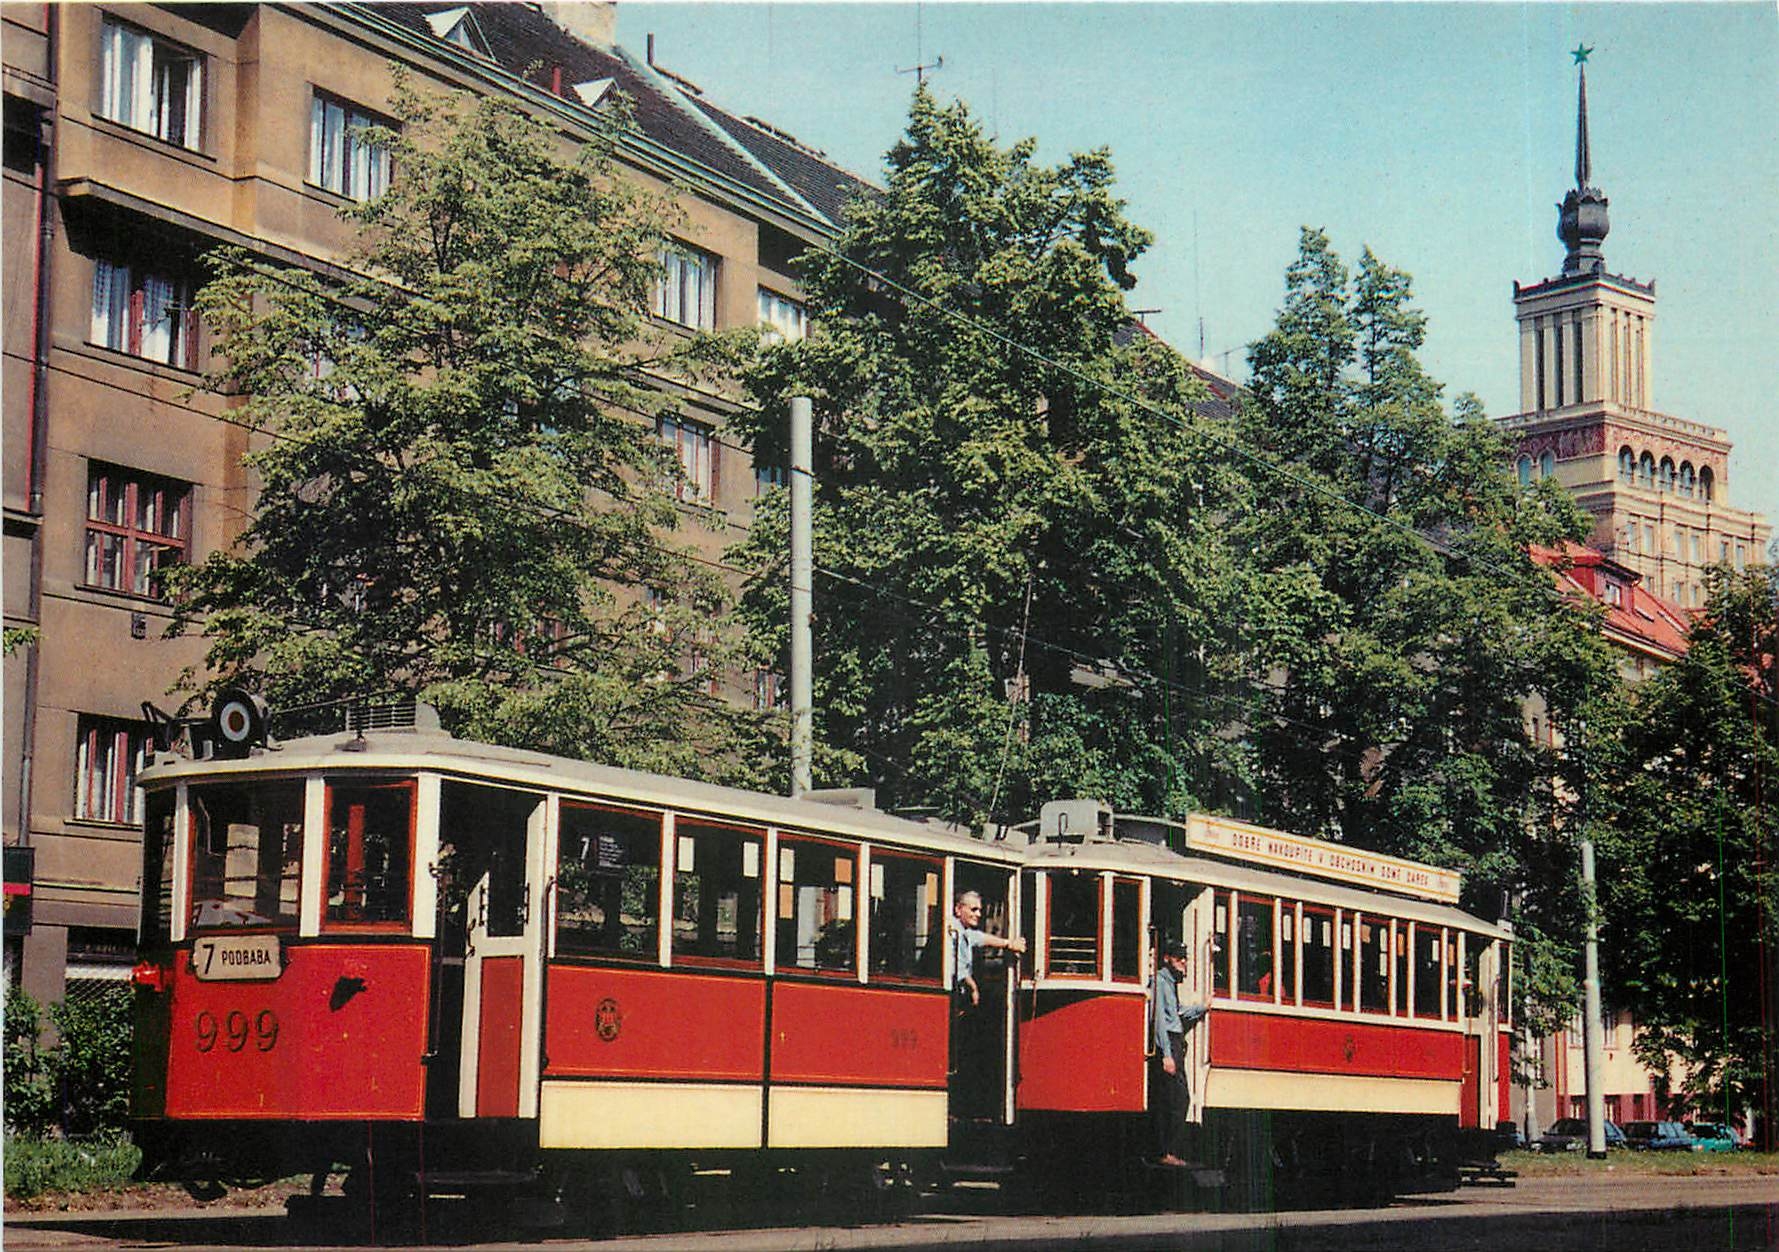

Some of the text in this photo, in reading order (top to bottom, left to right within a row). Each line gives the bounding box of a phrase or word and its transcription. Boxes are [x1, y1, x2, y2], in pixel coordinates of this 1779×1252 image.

[202, 943, 272, 975] 7 PODBABA
[195, 1009, 279, 1053] 999
